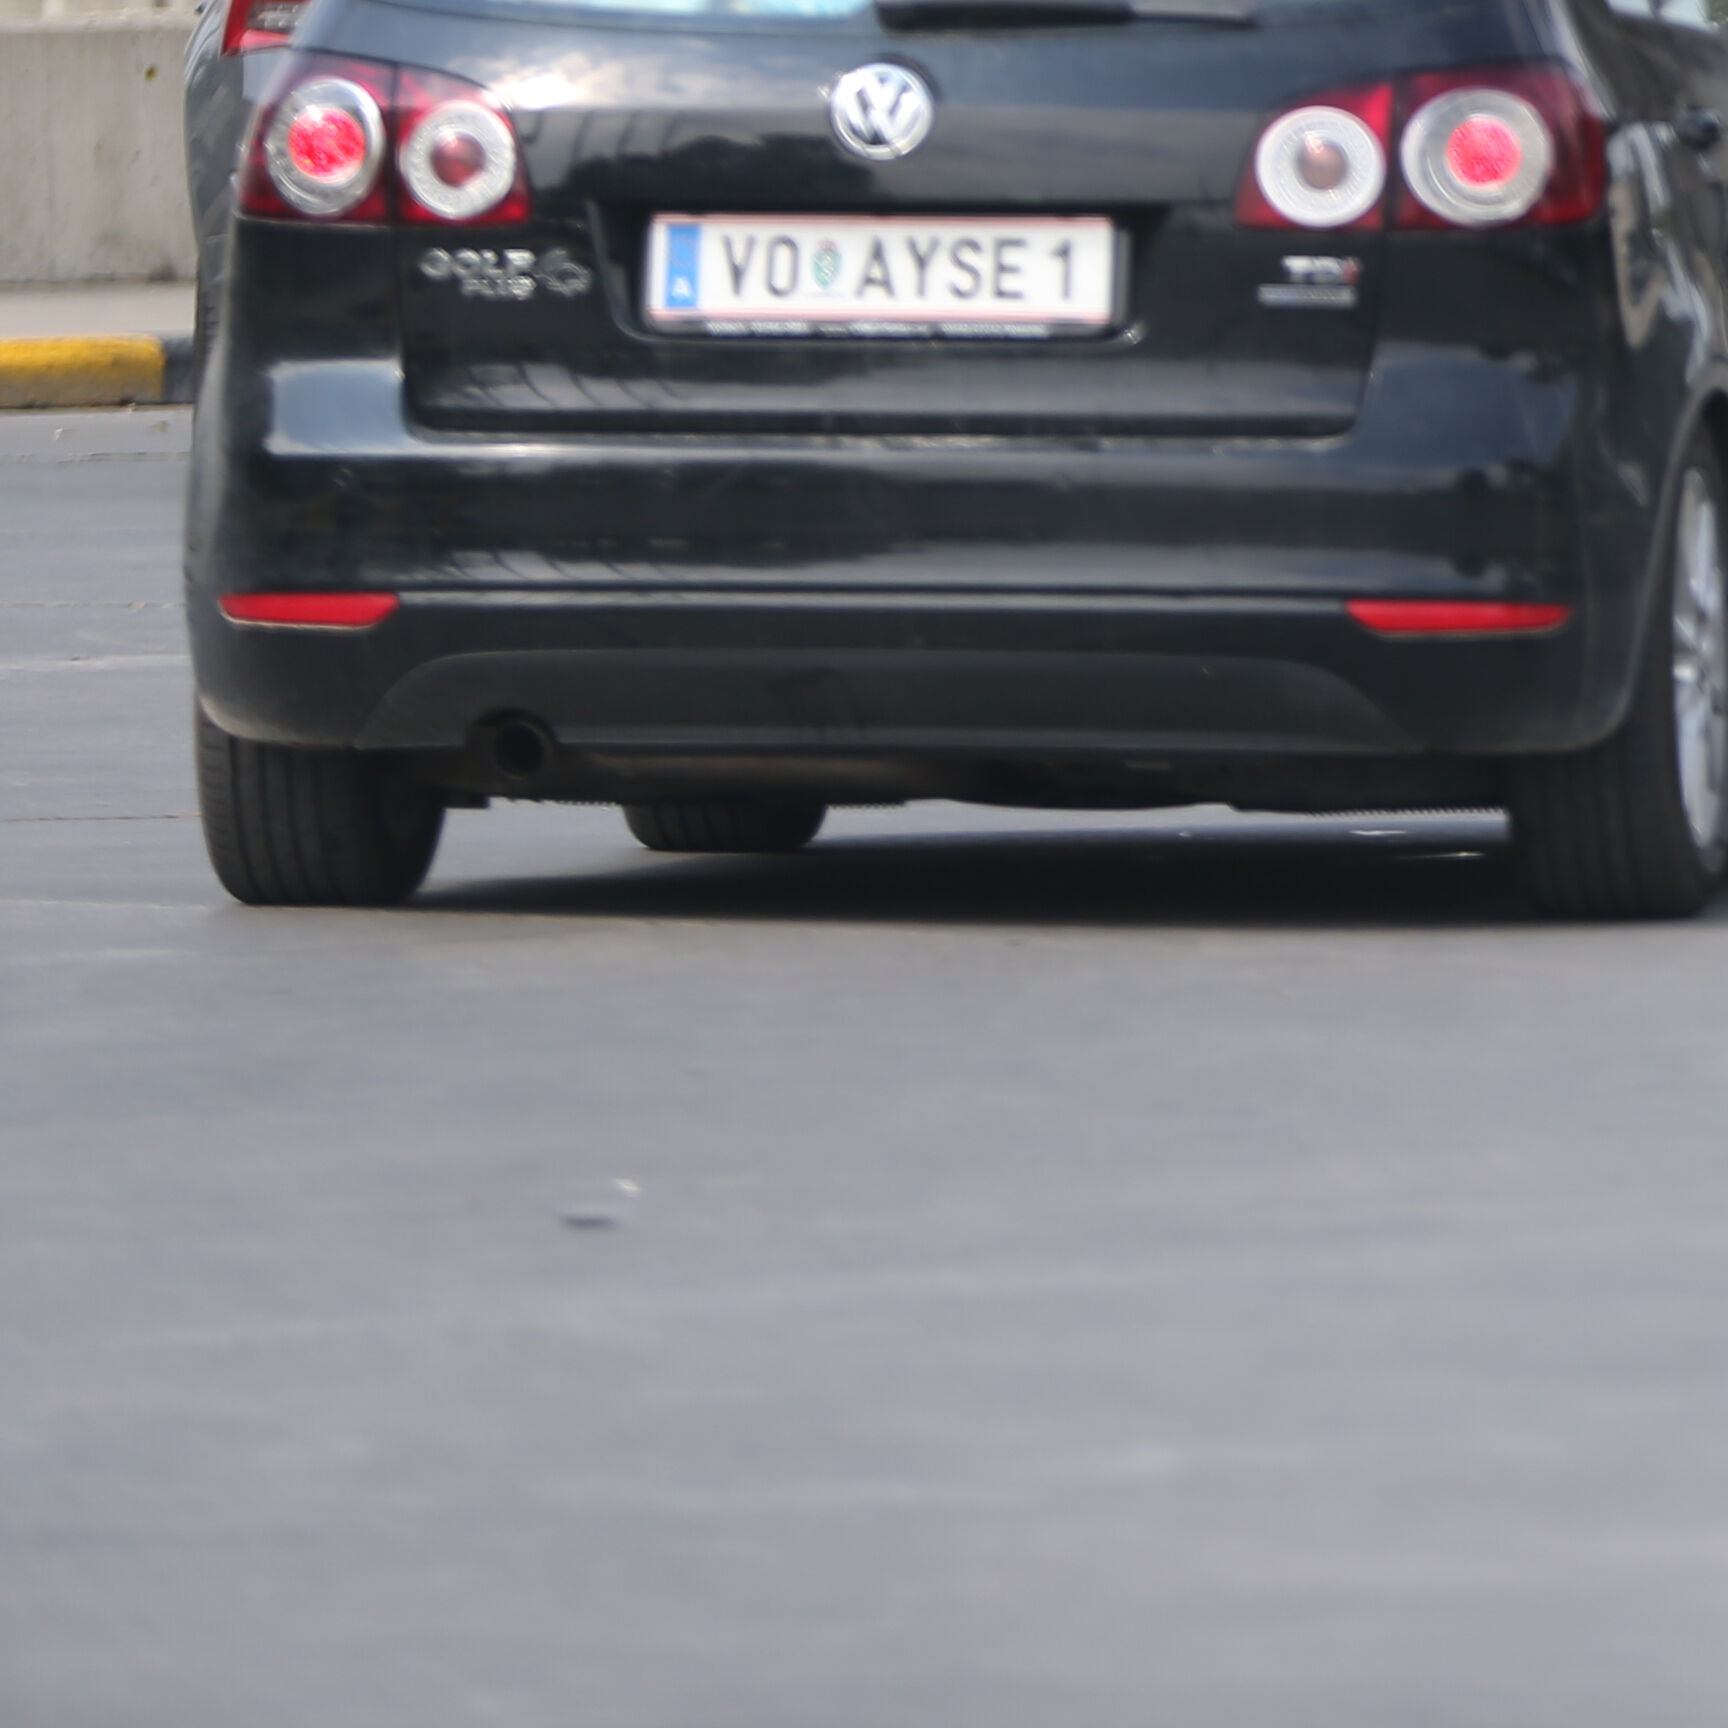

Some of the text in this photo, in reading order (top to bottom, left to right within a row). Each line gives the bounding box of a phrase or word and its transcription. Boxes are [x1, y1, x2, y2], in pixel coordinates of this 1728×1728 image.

[671, 275, 692, 298] A
[722, 234, 1073, 300] VO AYSE 1
